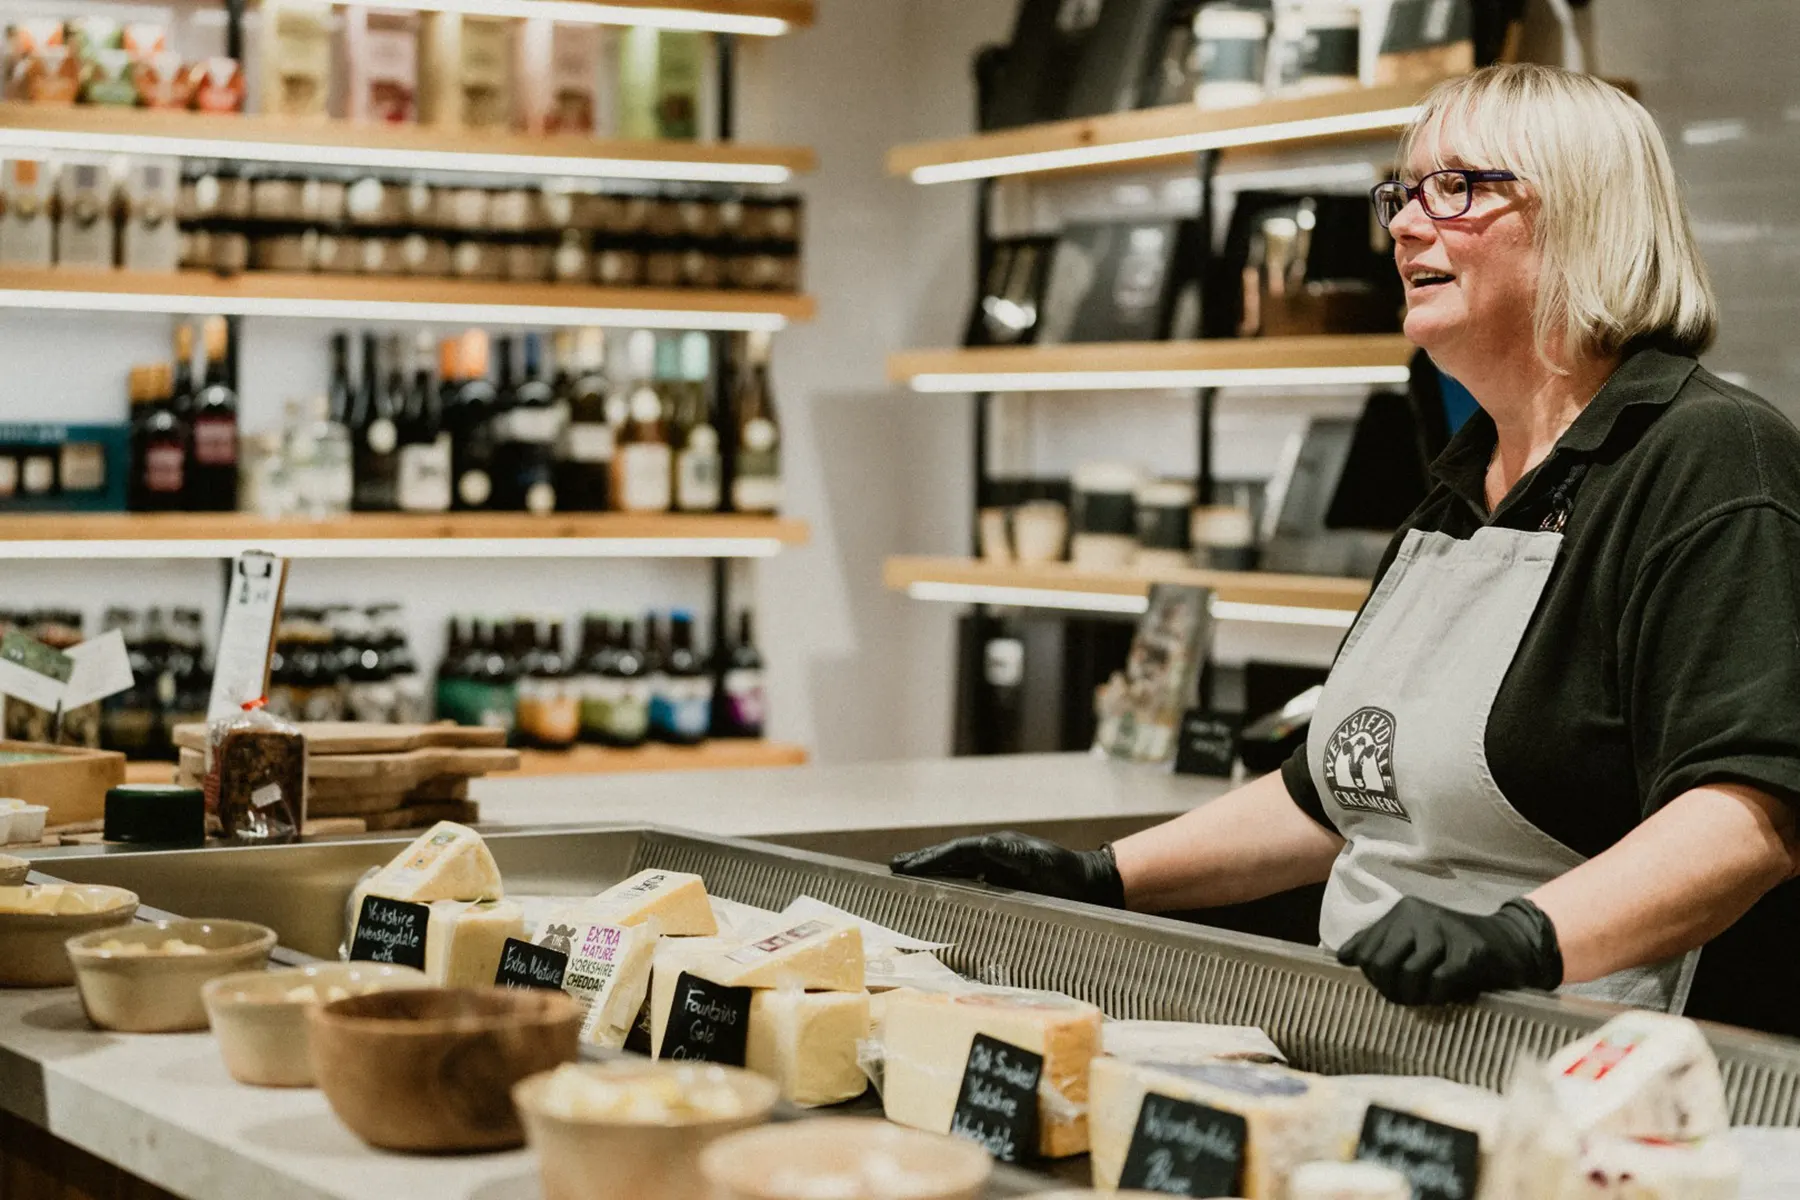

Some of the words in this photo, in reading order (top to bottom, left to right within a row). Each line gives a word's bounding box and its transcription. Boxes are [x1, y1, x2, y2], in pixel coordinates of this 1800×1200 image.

[1326, 713, 1392, 787] WENSLEYDALE
[1334, 789, 1404, 814] CREAMERY
[586, 925, 621, 946] EXTRA
[503, 945, 527, 976] Extra
[580, 943, 617, 962] MATURE
[569, 957, 616, 978] YORKSHIRE
[565, 972, 606, 993] CHEDDAR
